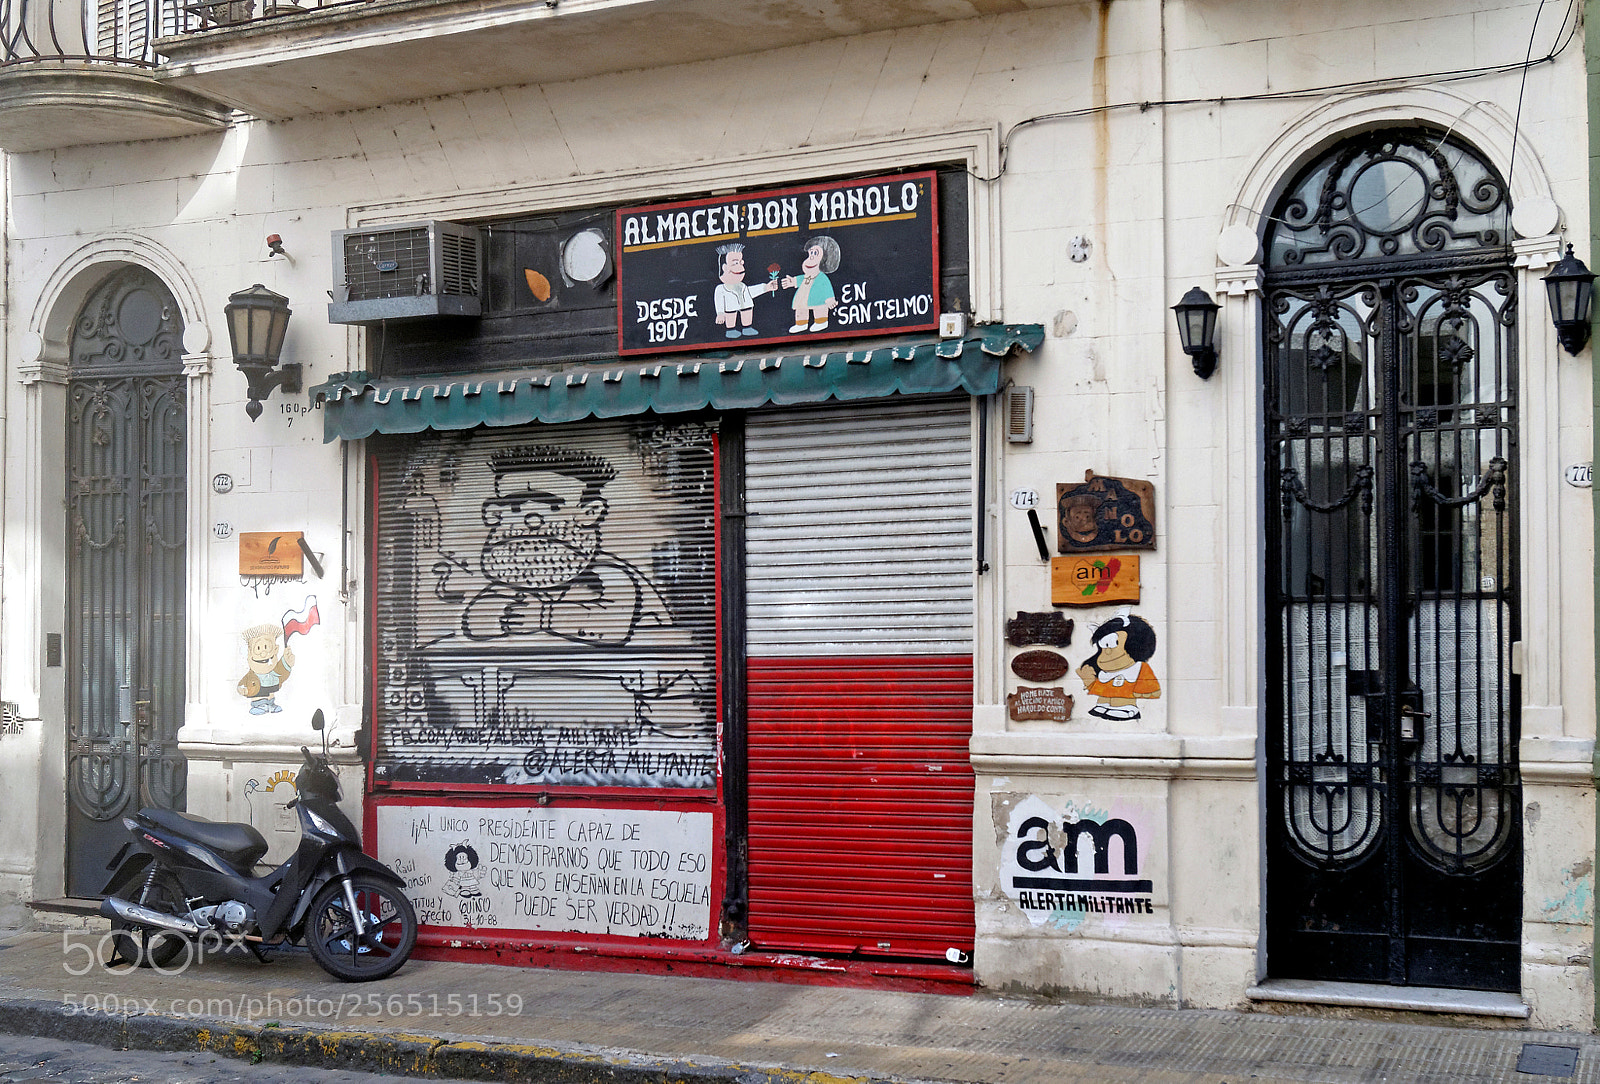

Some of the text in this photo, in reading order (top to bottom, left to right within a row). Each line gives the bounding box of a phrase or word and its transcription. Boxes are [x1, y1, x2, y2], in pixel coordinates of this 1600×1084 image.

[841, 281, 867, 304] EN
[636, 295, 698, 324] DESDE
[647, 319, 689, 343] 1907
[217, 476, 229, 486] 772
[1014, 491, 1034, 505] 774
[217, 523, 229, 535] 772
[1076, 566, 1111, 580] am
[523, 749, 713, 777] @ALERTA MILITANTE
[567, 820, 615, 842] CAPAZ
[621, 823, 640, 841] DE
[490, 842, 706, 873] DEMOSTRARNOS QUE TODO ESO
[1017, 816, 1138, 875] am
[490, 867, 514, 891] QUE
[521, 870, 546, 891] NOS
[555, 873, 609, 896] ENSEÑAN
[651, 878, 709, 907] ESCUELA
[515, 892, 561, 917] PUEDE
[566, 898, 598, 923] SER
